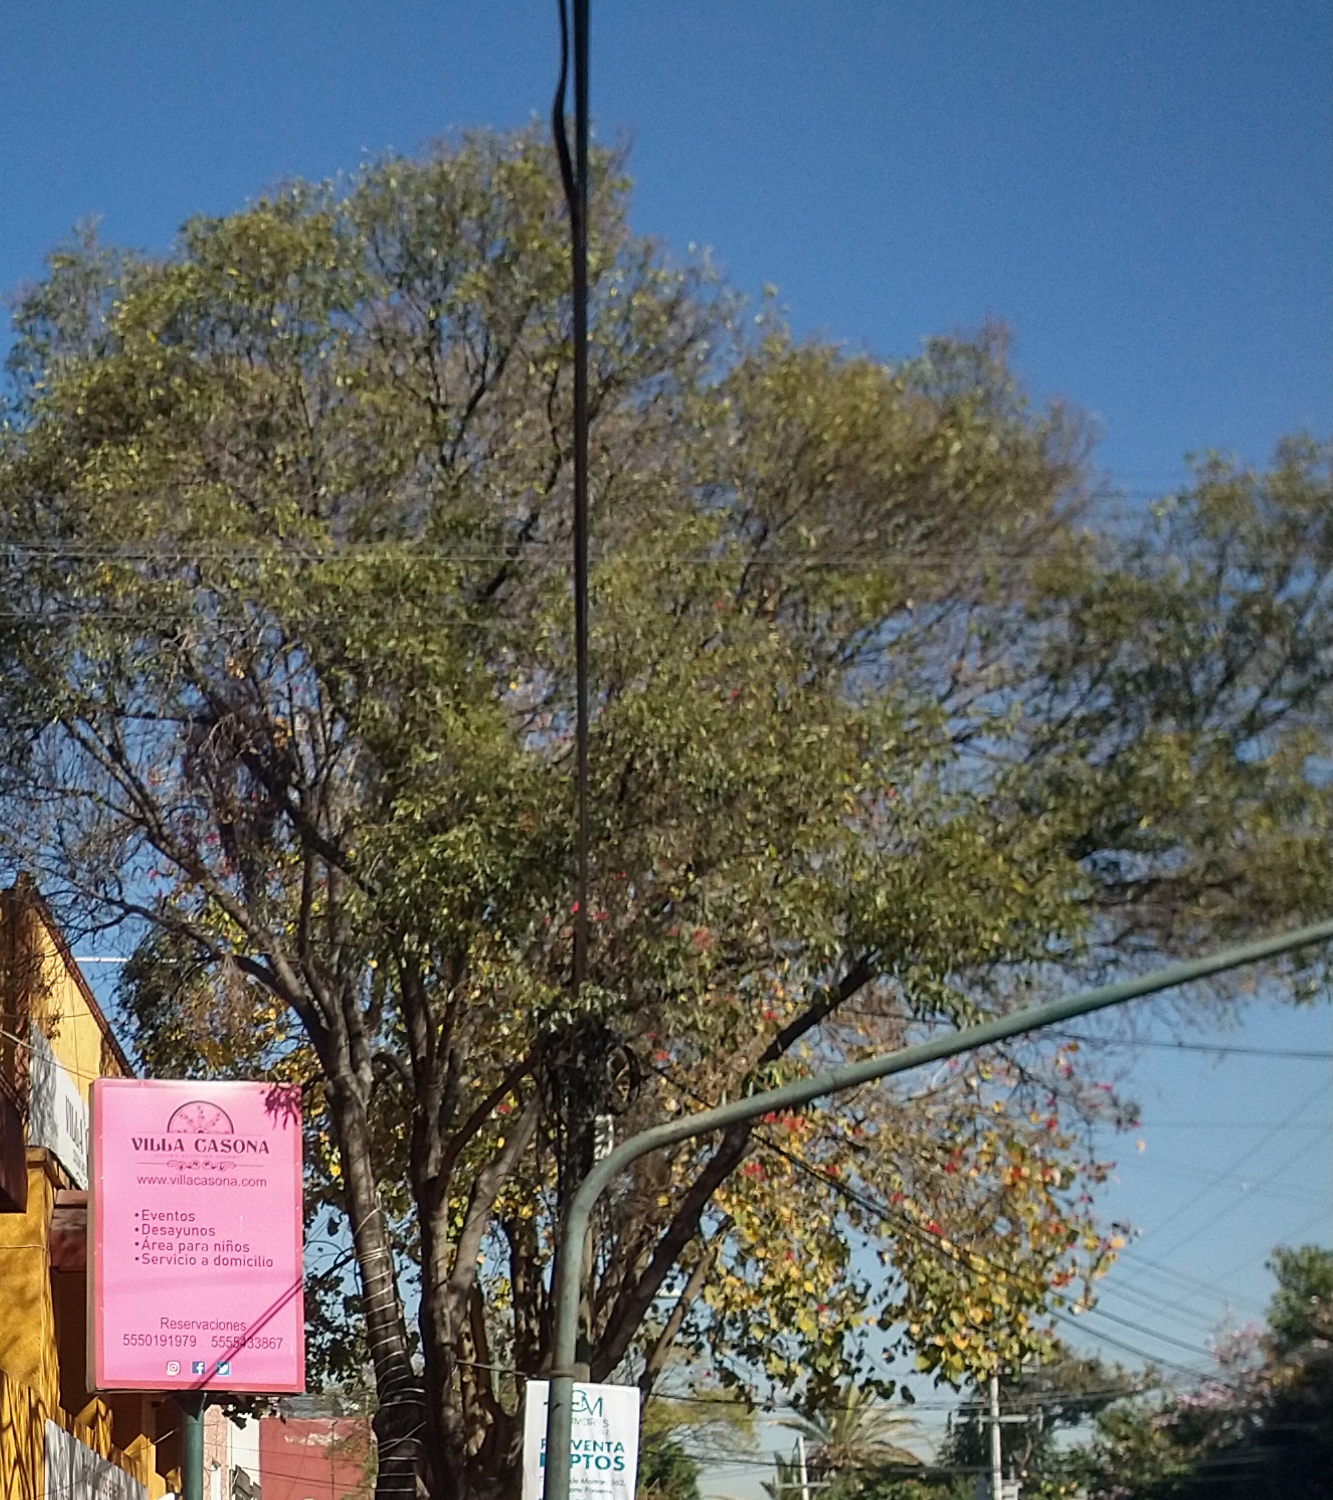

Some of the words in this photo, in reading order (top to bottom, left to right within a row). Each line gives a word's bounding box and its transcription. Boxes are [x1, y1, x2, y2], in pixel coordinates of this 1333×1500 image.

[132, 1137, 185, 1152] VILLA
[194, 1138, 270, 1154] CASONA
[137, 1174, 267, 1187] www.villacasona.com
[141, 1209, 196, 1222] Eventos
[141, 1223, 216, 1238] Desayunos
[141, 1236, 174, 1251] Área
[178, 1241, 209, 1254] para
[214, 1240, 250, 1253] niños
[141, 1252, 197, 1266] Servicio
[201, 1256, 209, 1266] a
[213, 1254, 274, 1268] domicilio
[160, 1316, 247, 1331] Reservaciones
[123, 1333, 197, 1348] 5550191979
